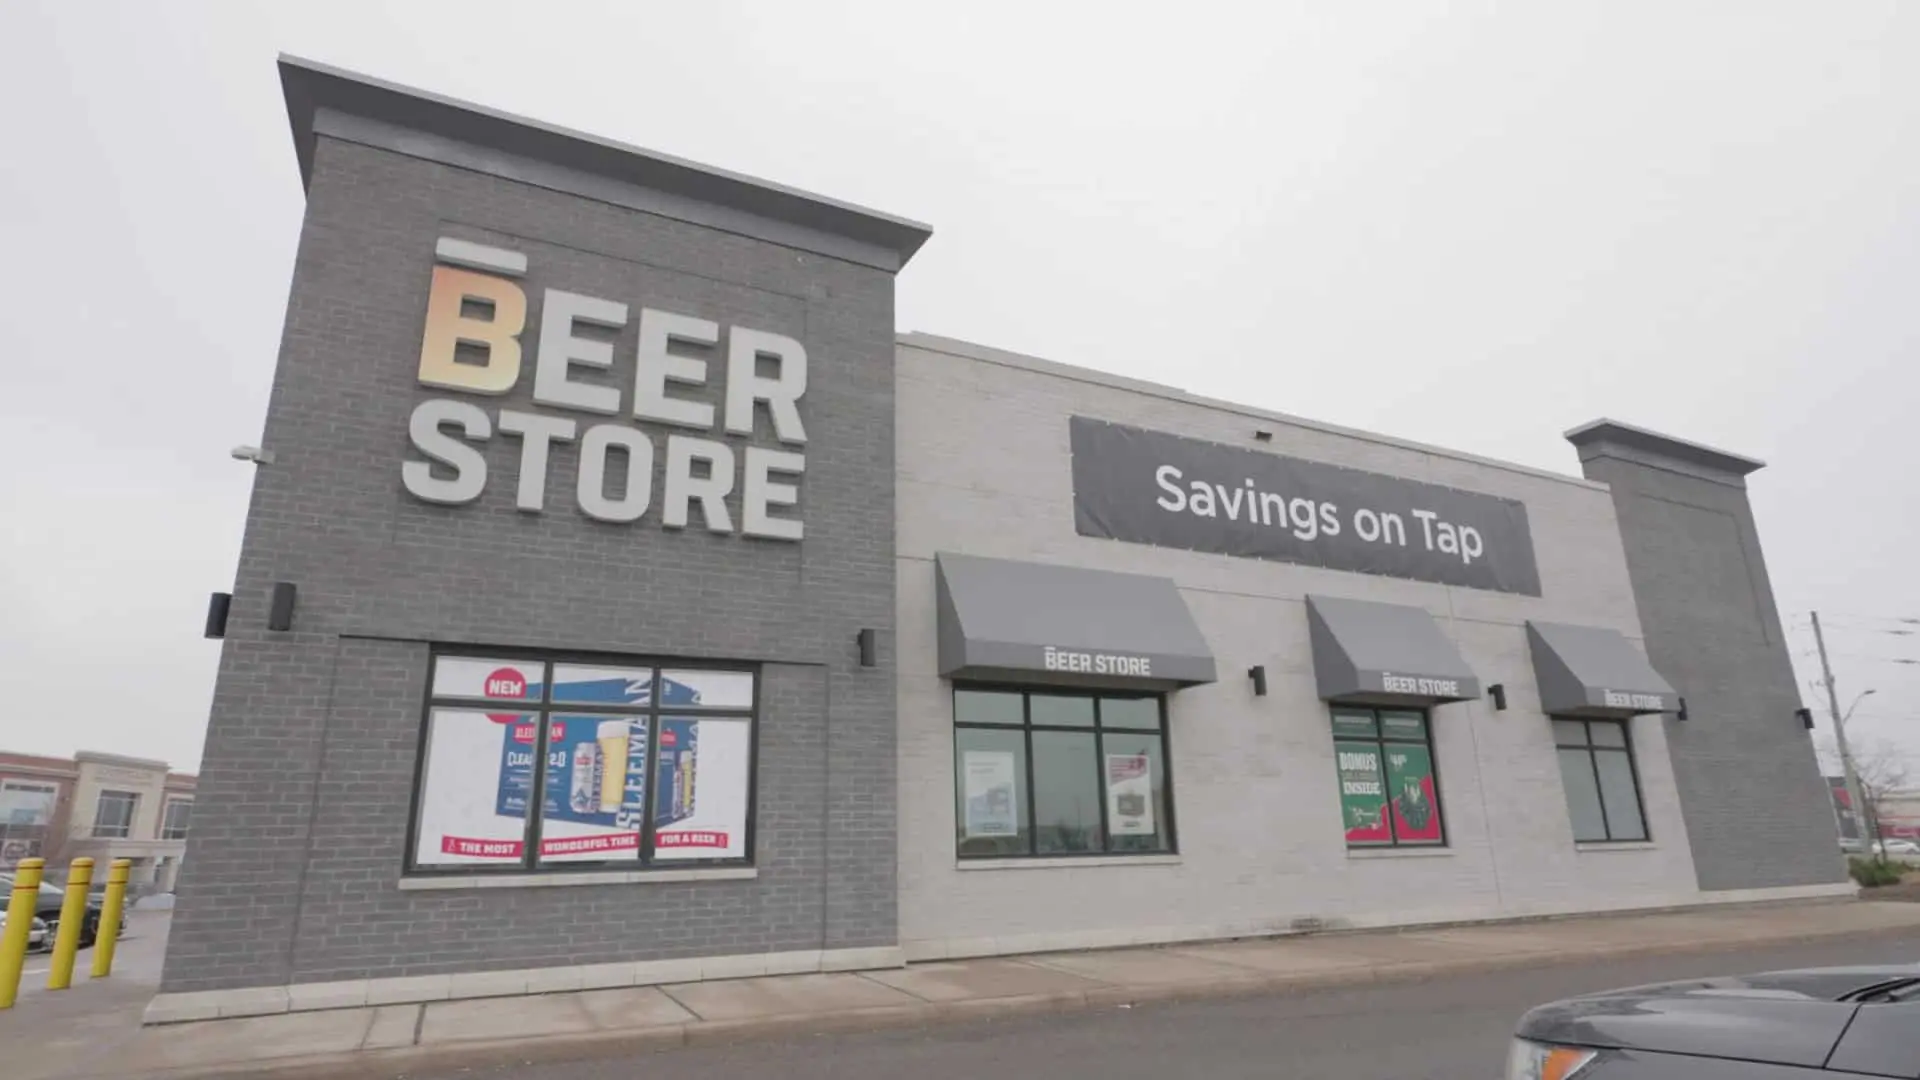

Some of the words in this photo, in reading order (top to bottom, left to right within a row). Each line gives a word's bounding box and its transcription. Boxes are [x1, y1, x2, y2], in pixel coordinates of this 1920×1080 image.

[418, 237, 808, 443] BEER
[402, 399, 806, 540] STORE
[1155, 465, 1340, 541] Savings
[1354, 508, 1406, 546] on
[1413, 509, 1483, 564] Tap
[1044, 646, 1092, 672] BEER
[1095, 654, 1151, 677] STORE
[489, 679, 522, 696] NEW
[1383, 672, 1416, 693] BEER
[1418, 679, 1459, 696] STORE
[1339, 752, 1377, 771] BONUS
[460, 841, 481, 853] THE
[483, 843, 515, 855] MOST
[544, 838, 609, 852] WONDERFUL
[611, 836, 637, 848] TIME
[661, 834, 680, 845] FOR
[682, 834, 691, 844] A
[692, 834, 718, 844] BEER
